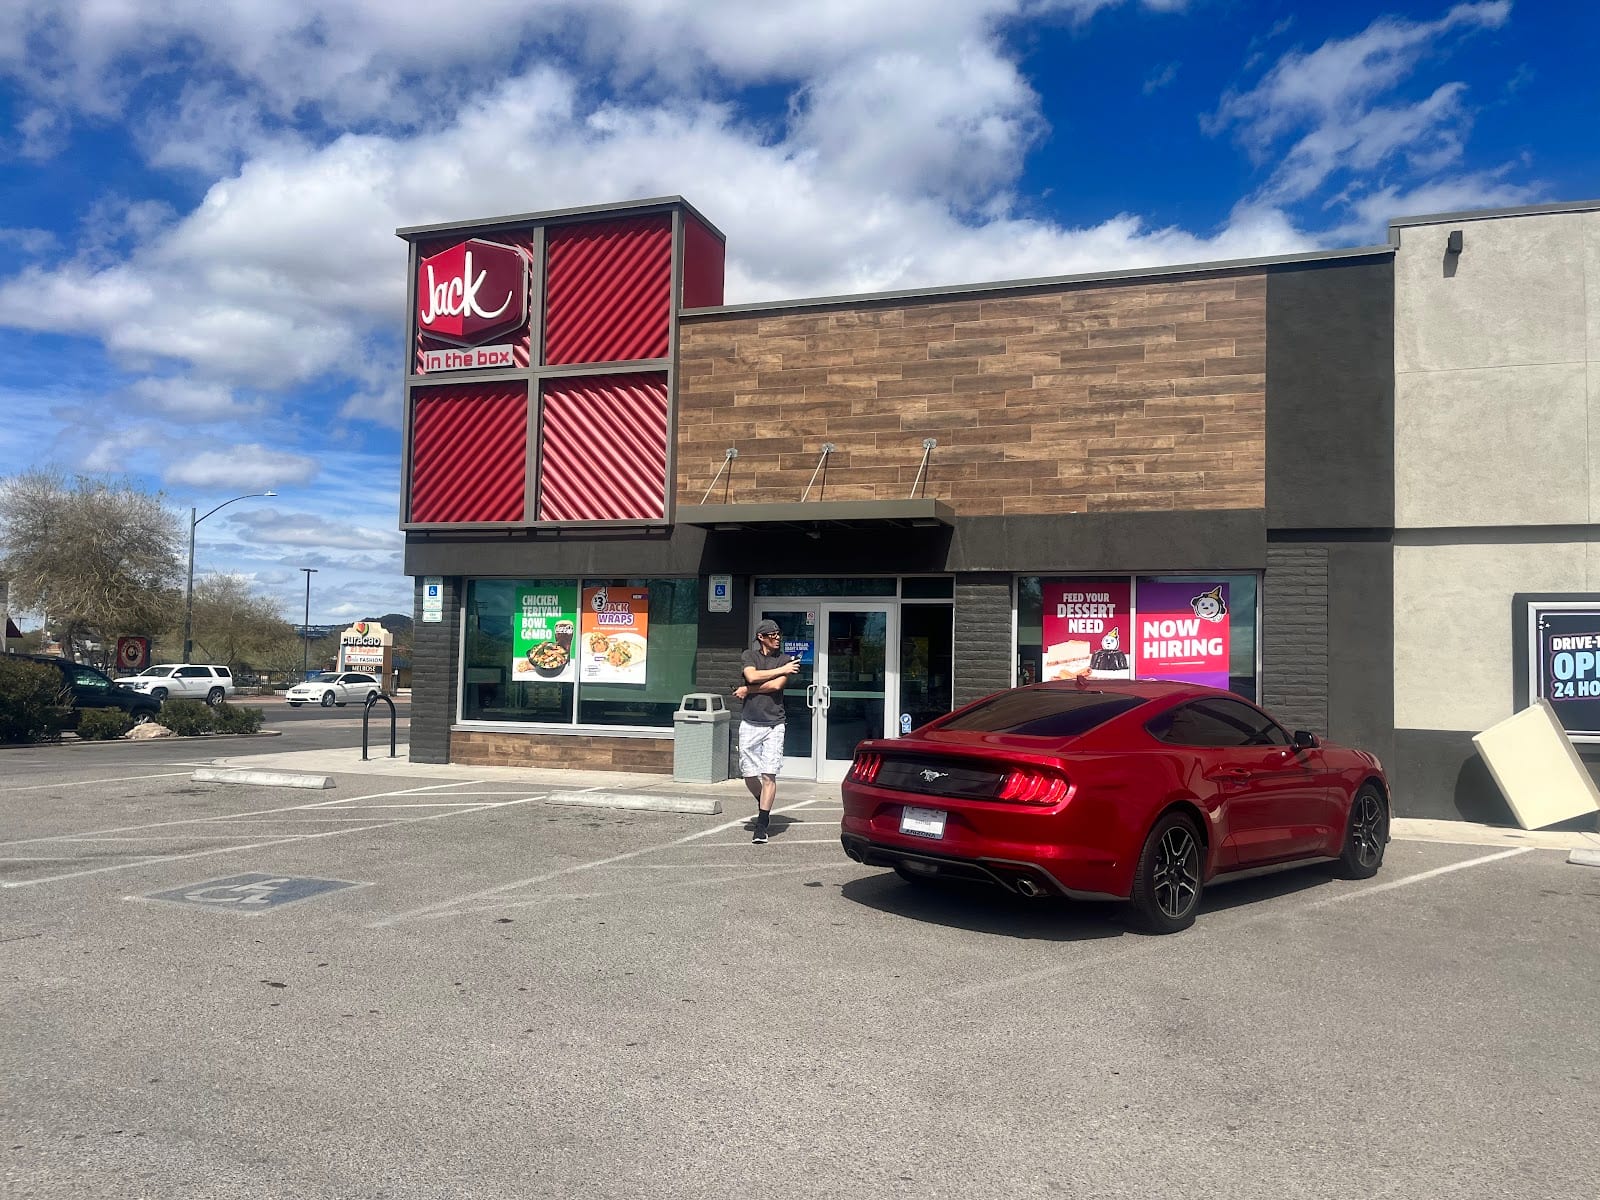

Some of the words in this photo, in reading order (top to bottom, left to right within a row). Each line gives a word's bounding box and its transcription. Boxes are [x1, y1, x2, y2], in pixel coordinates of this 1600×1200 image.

[421, 251, 513, 325] Jack
[426, 354, 441, 369] in
[445, 352, 473, 368] the
[477, 350, 510, 366] box
[522, 595, 559, 606] CHICKEN
[1063, 593, 1084, 603] FEED
[1086, 593, 1110, 602] YOUR
[522, 607, 562, 617] TERIYAKI
[604, 603, 629, 613] JACK
[1057, 603, 1116, 618] DESSERT
[522, 618, 547, 628] BOWL
[598, 614, 634, 624] WRAPS
[1068, 619, 1104, 633] NEED
[1143, 619, 1200, 638] NOW
[521, 629, 552, 639] COMBO
[1143, 638, 1223, 659] HIRING
[1554, 682, 1574, 697] 24
[1578, 681, 1600, 696] HO
